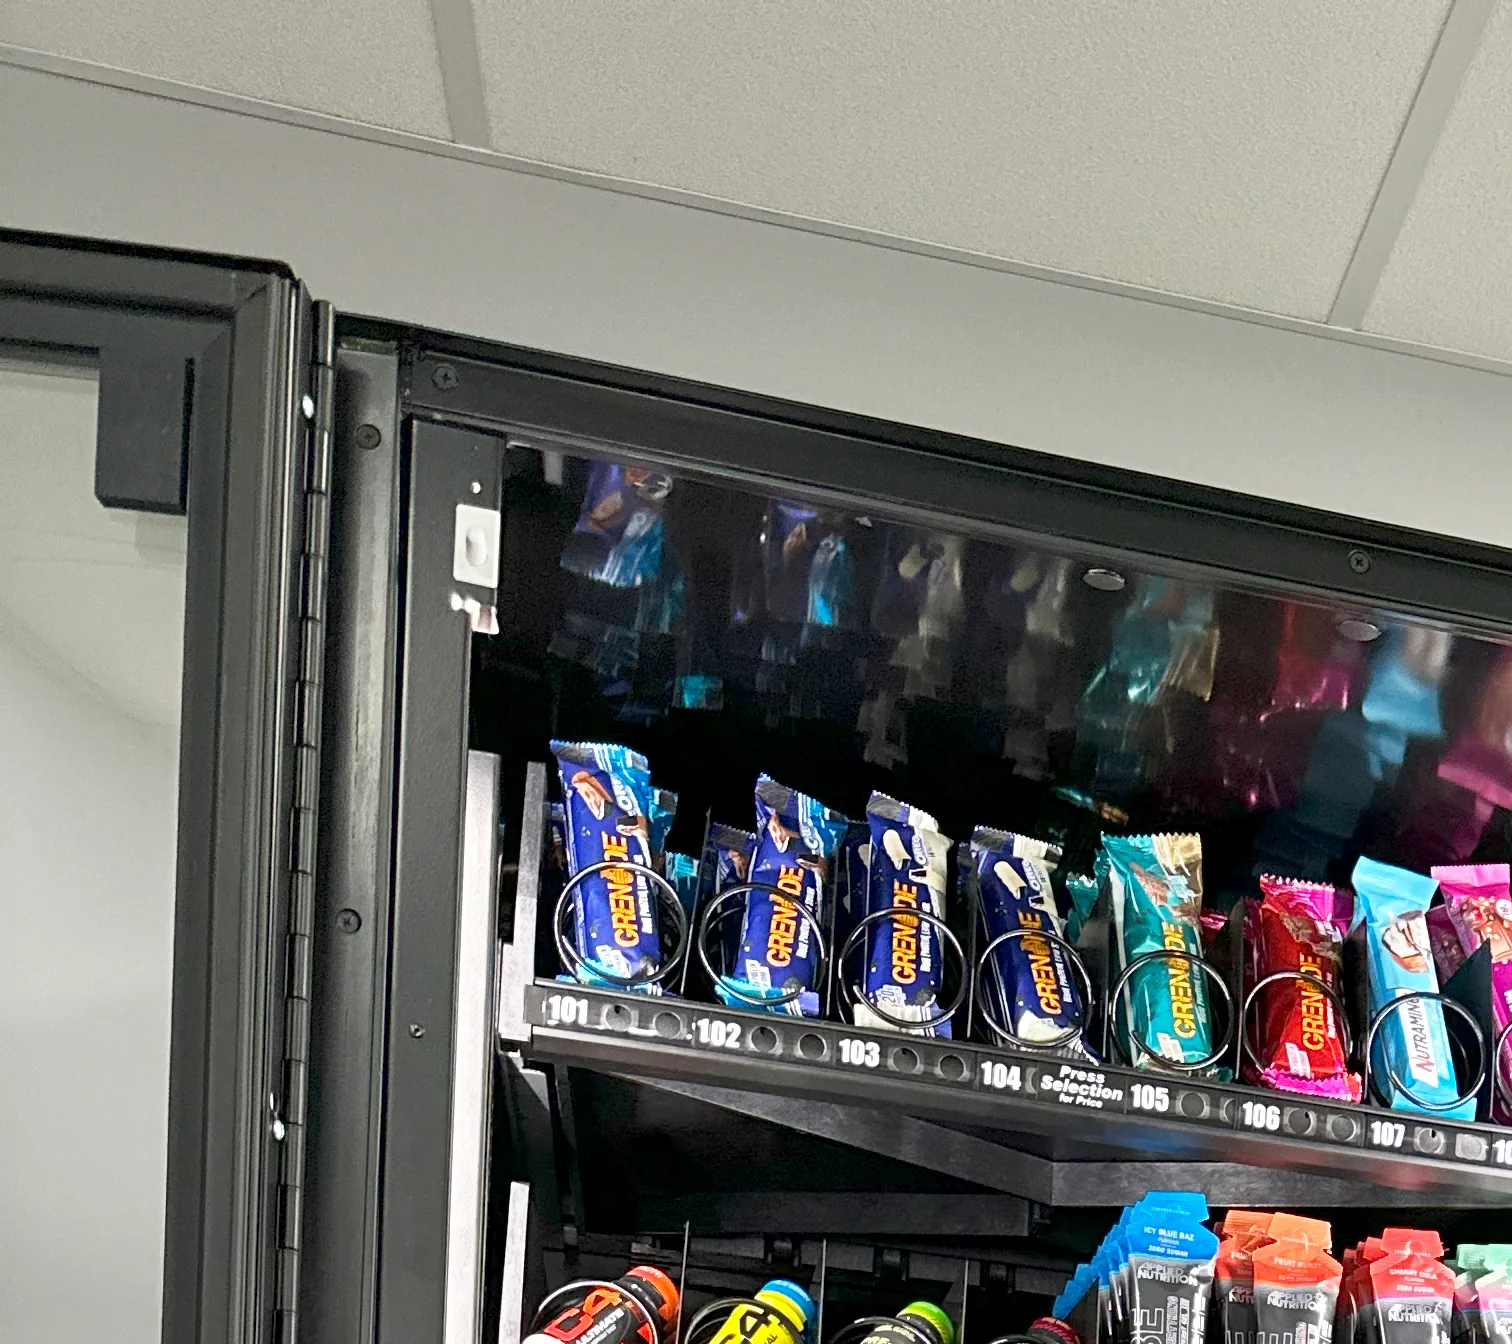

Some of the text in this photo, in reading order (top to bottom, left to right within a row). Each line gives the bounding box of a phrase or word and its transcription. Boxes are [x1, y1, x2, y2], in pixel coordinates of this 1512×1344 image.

[549, 995, 588, 1024] 101
[697, 1019, 742, 1048] 102
[838, 1038, 880, 1067] 103
[981, 1061, 1022, 1090] 104
[1040, 1074, 1123, 1101] Selection
[1059, 1065, 1105, 1084] Press
[1130, 1083, 1169, 1112] 105
[1243, 1101, 1281, 1131] 106
[1371, 1122, 1405, 1147] 107
[543, 1287, 623, 1342] C4
